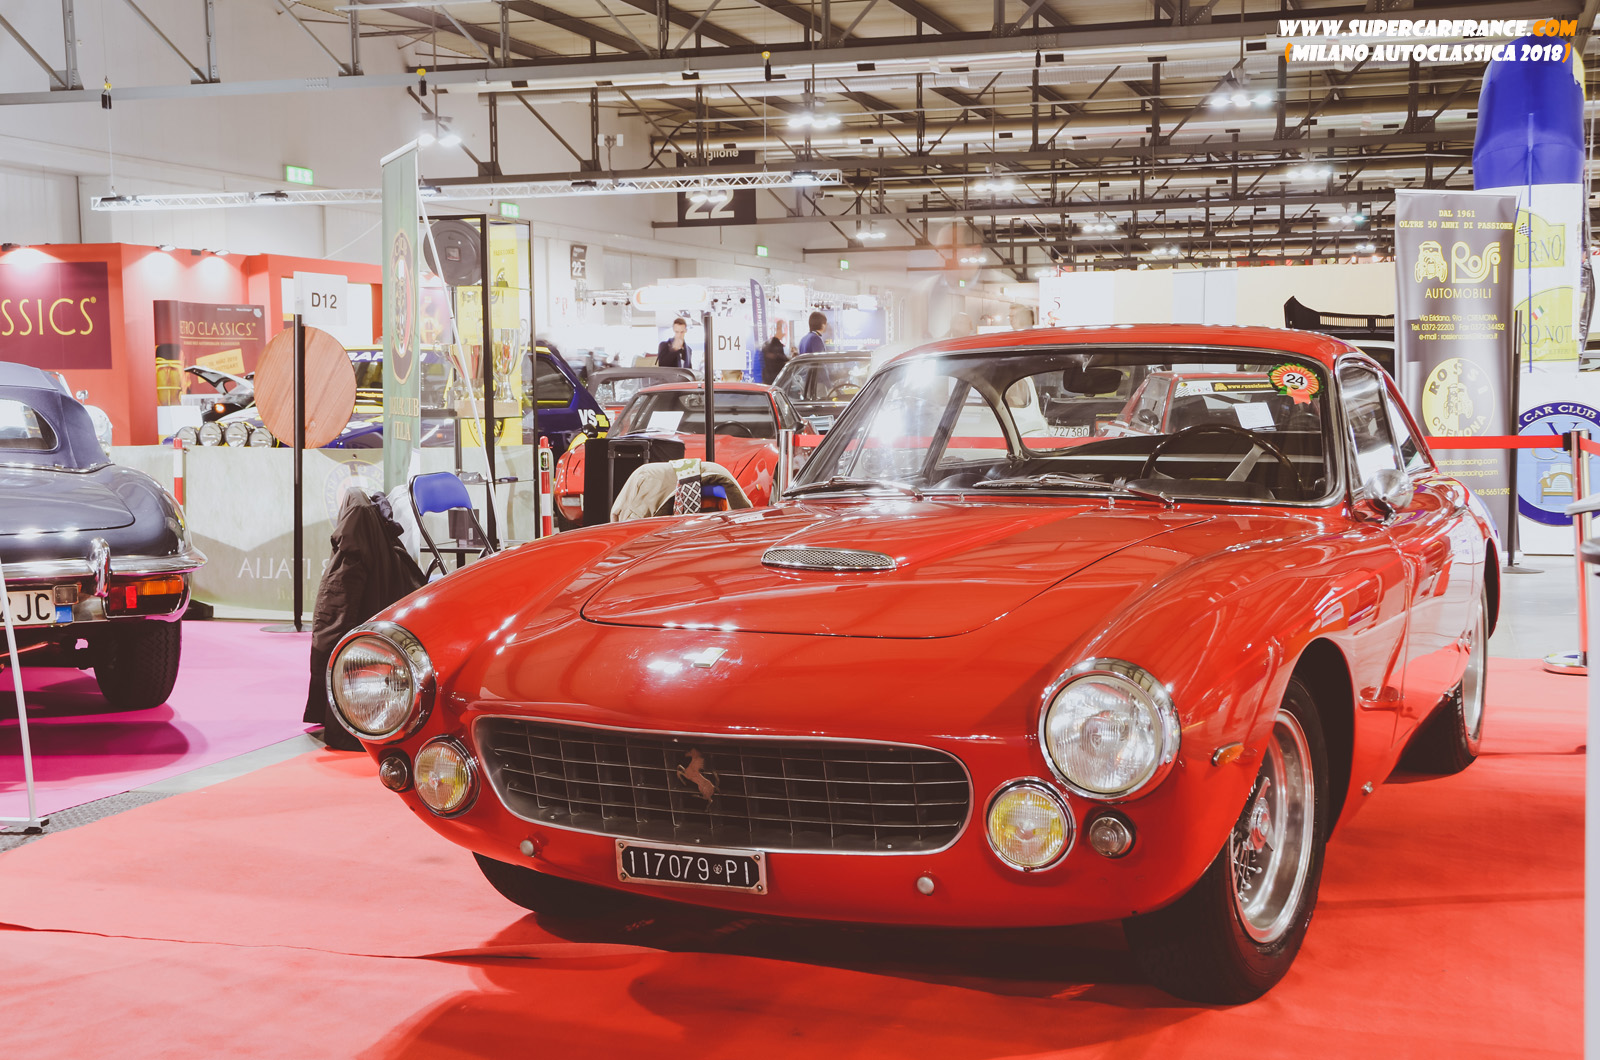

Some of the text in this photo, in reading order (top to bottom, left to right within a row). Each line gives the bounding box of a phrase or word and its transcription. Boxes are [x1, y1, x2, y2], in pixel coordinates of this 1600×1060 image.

[1438, 209, 1475, 218] DAL 1961
[1399, 220, 1424, 228] OLTRE
[1440, 221, 1459, 229] ANNI
[1477, 222, 1513, 230] PASSIONE
[311, 292, 338, 310] D12
[1424, 288, 1492, 299] AUTOMOBILI
[718, 335, 741, 351] D14
[1286, 373, 1305, 386] 24
[1428, 362, 1489, 395] ROSSI
[1523, 404, 1598, 423] CAR CLUB
[629, 850, 710, 881] 117079
